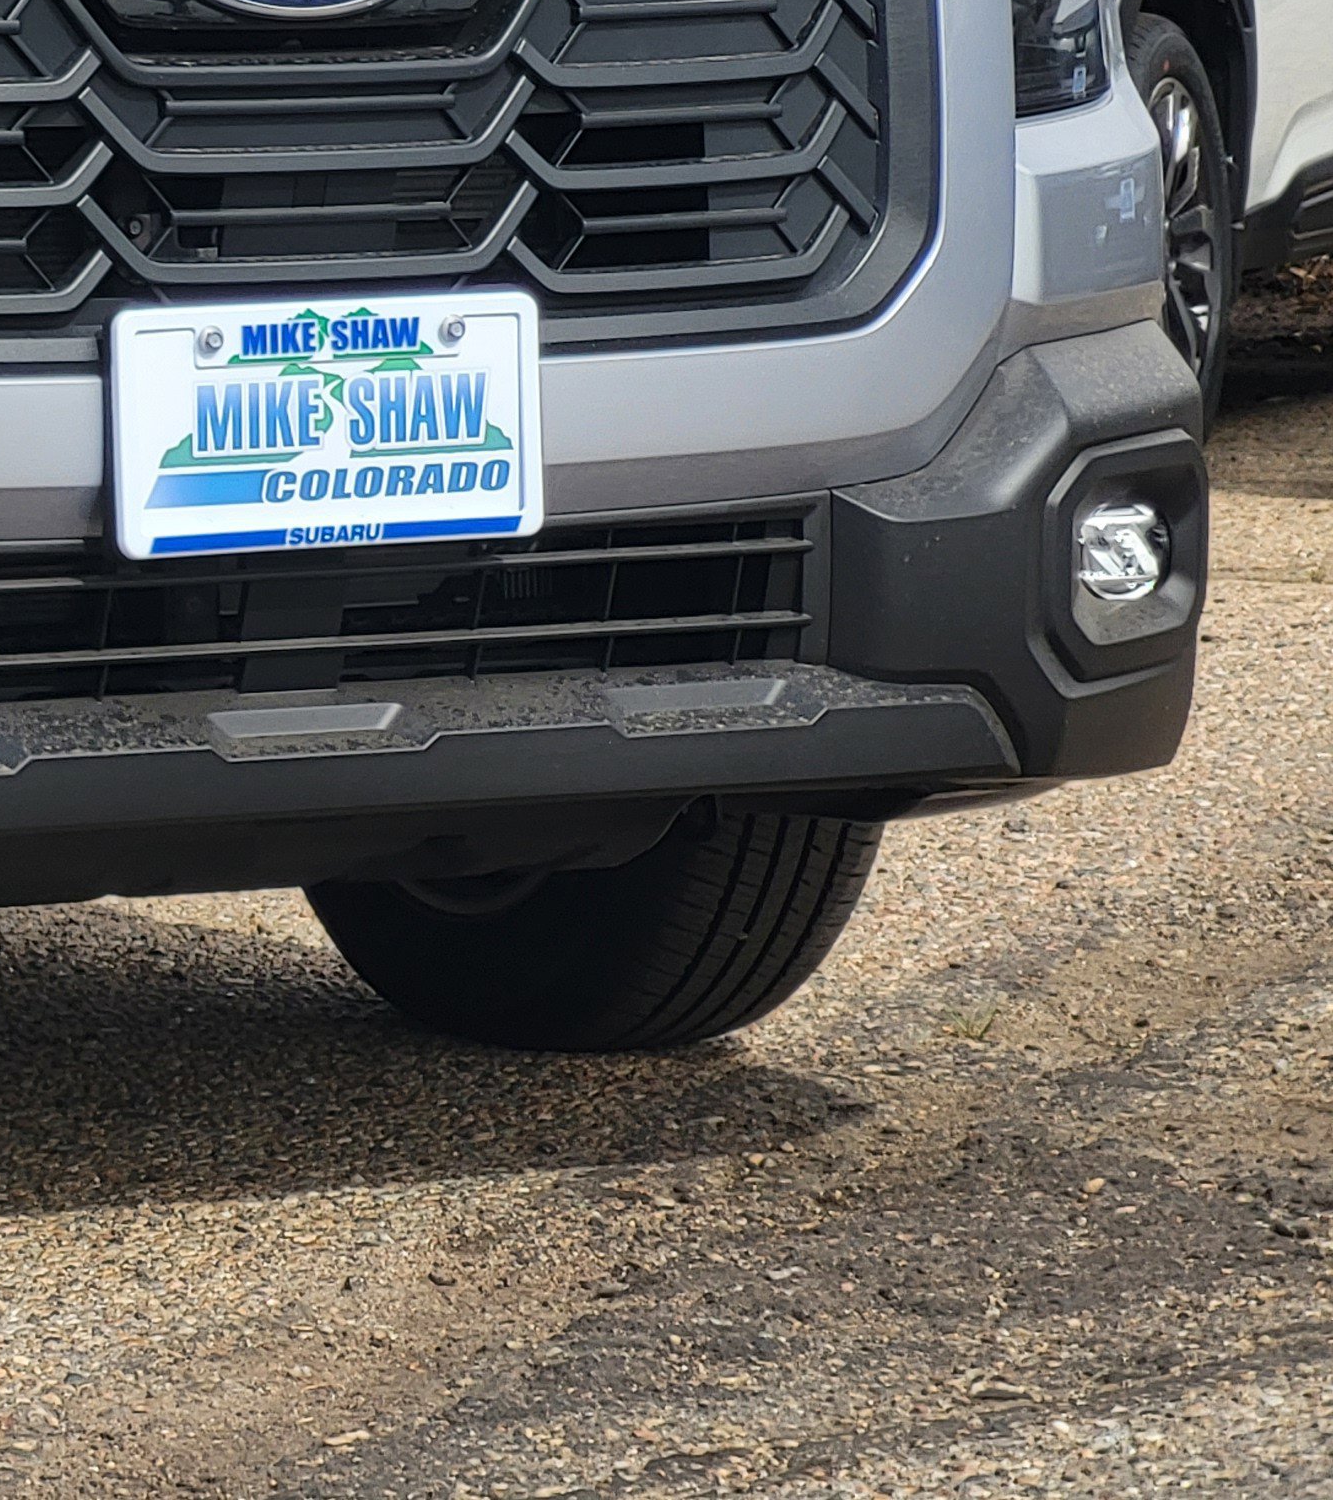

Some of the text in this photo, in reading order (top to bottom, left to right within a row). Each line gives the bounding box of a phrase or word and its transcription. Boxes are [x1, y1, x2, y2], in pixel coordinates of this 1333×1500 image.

[241, 316, 420, 356] MIKE SHAW
[196, 372, 487, 453] MIKE SHAW
[264, 458, 511, 504] COLORADO
[288, 522, 384, 545] SUBARU
